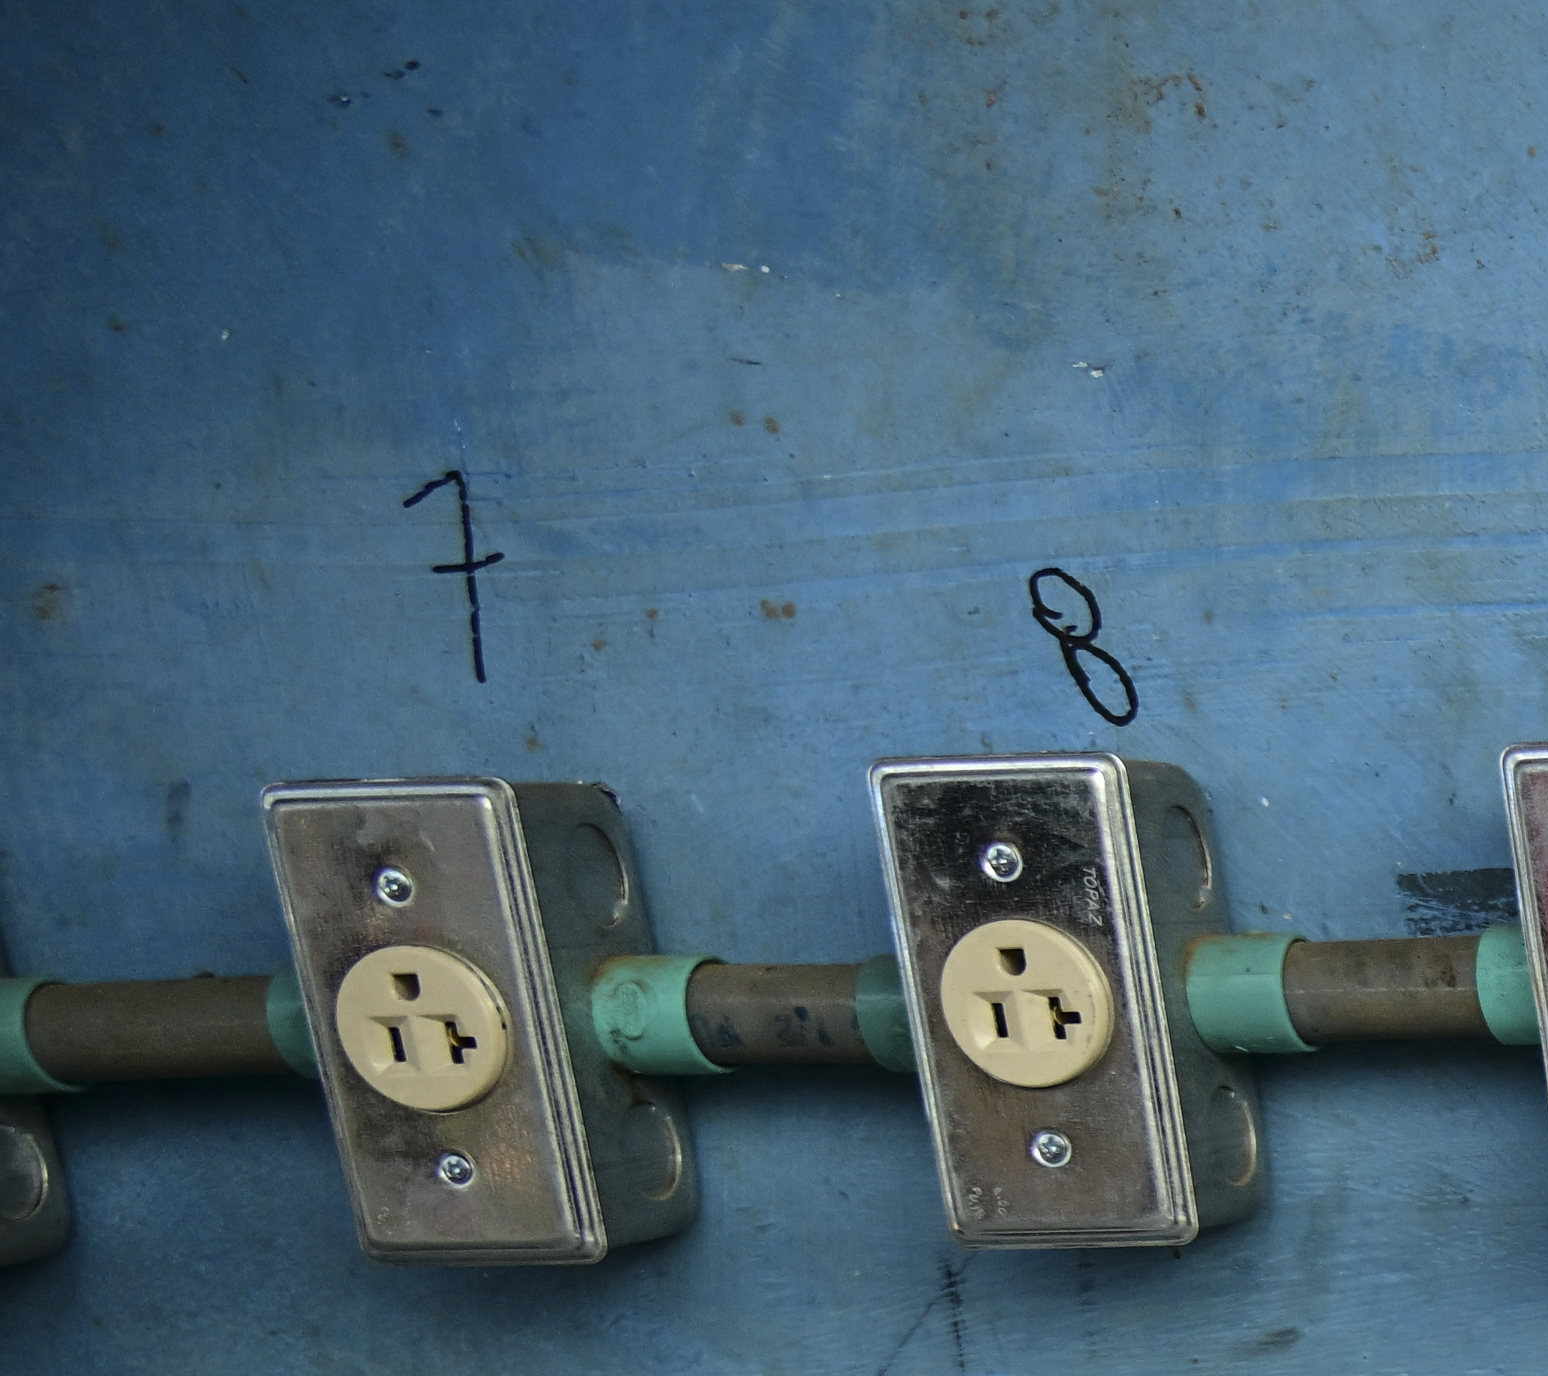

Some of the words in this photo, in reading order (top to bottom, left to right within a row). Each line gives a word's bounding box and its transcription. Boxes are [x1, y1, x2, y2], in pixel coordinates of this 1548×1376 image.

[403, 470, 505, 684] 7
[1029, 567, 1139, 727] 8
[1083, 866, 1103, 927] TOPAZ
